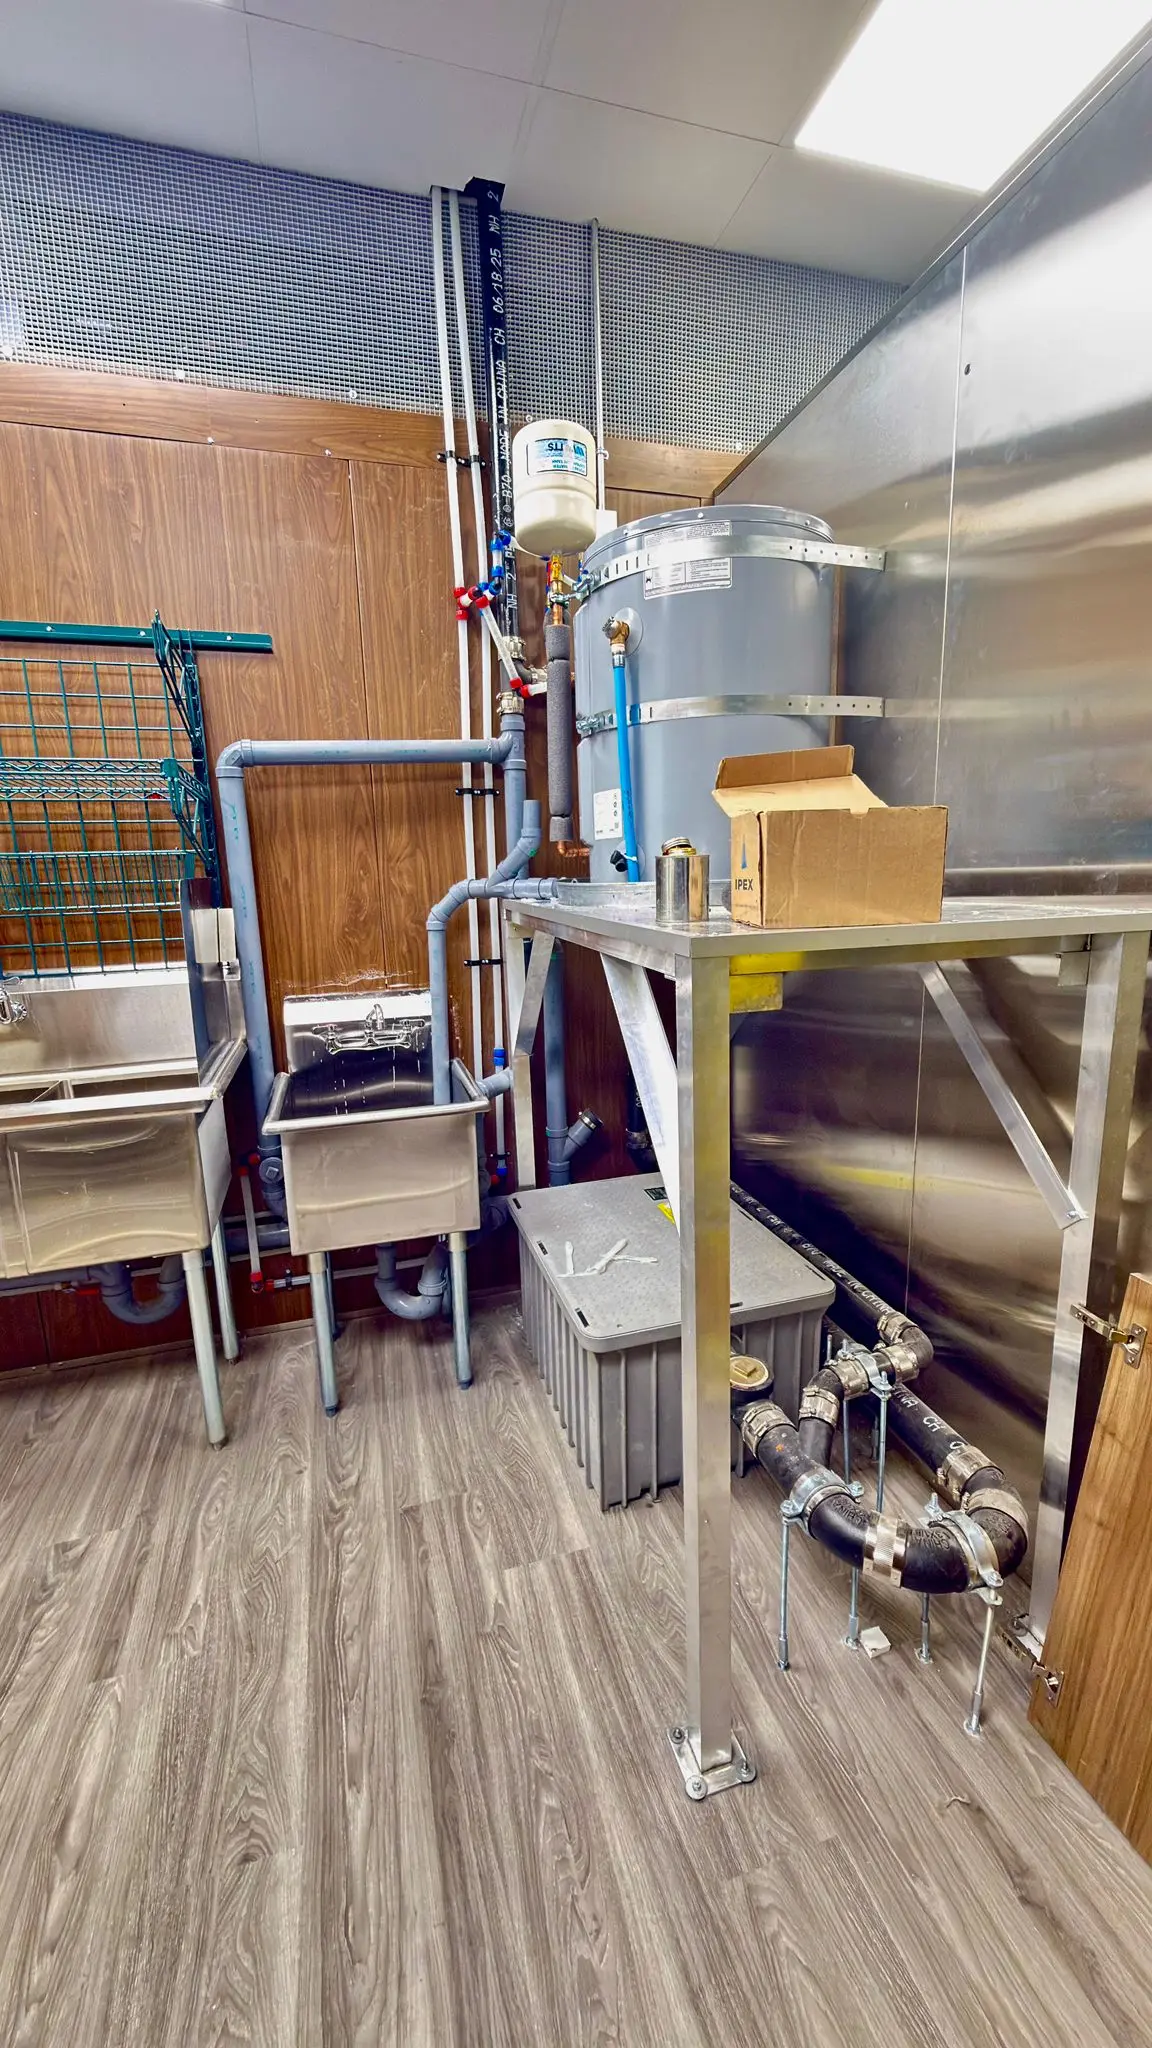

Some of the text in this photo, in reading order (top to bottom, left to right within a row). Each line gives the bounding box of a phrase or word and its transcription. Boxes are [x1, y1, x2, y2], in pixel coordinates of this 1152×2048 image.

[488, 214, 501, 235] NH
[490, 247, 505, 314] 06/18/25
[494, 327, 506, 346] CH
[496, 359, 508, 399] CHINA
[734, 878, 754, 891] IPEX
[847, 1279, 862, 1290] IN
[860, 1289, 894, 1315] CHINA
[889, 1385, 919, 1409] HINA
[923, 1416, 945, 1432] CH
